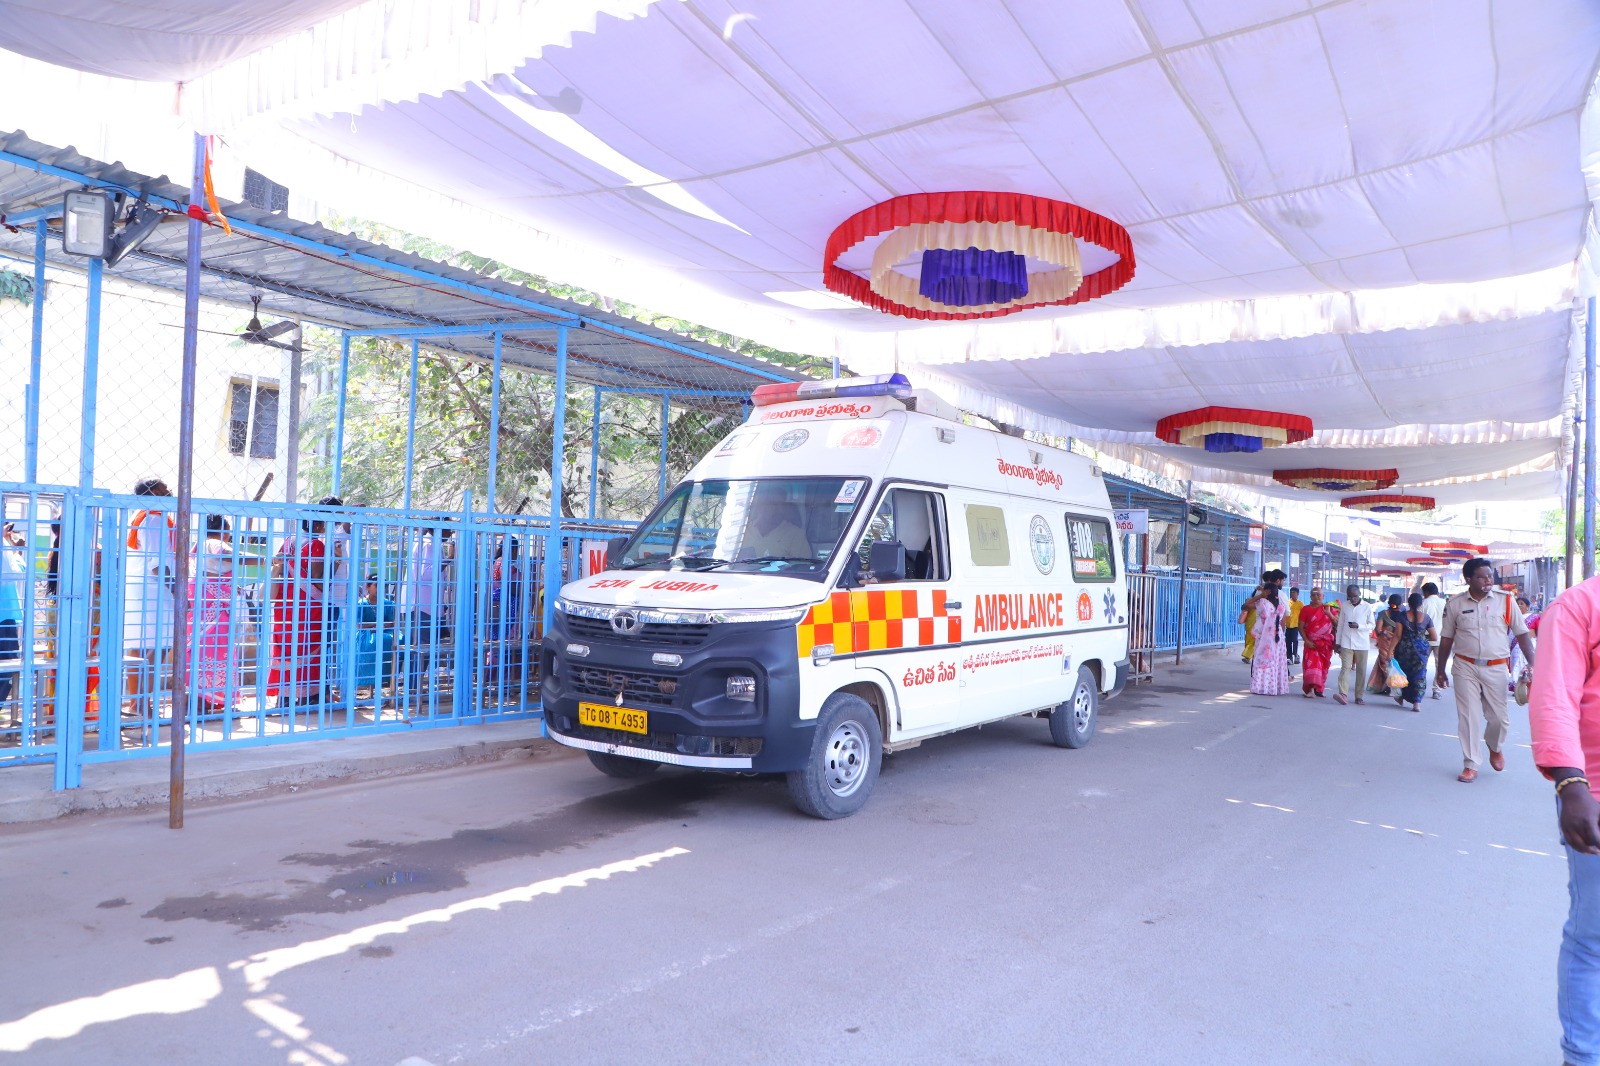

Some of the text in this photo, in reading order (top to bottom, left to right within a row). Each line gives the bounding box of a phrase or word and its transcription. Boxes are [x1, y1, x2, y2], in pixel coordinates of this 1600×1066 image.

[815, 403, 872, 418] ప్రభుత్వం
[996, 458, 1063, 490] తెలంగాణ ప్రభుత్వం
[1072, 521, 1094, 559] 108
[973, 592, 1064, 634] AMBULANCE
[1052, 644, 1064, 657] 108
[902, 660, 957, 688] ఉచిత సేవ
[585, 707, 646, 730] TG 08 T 4953
